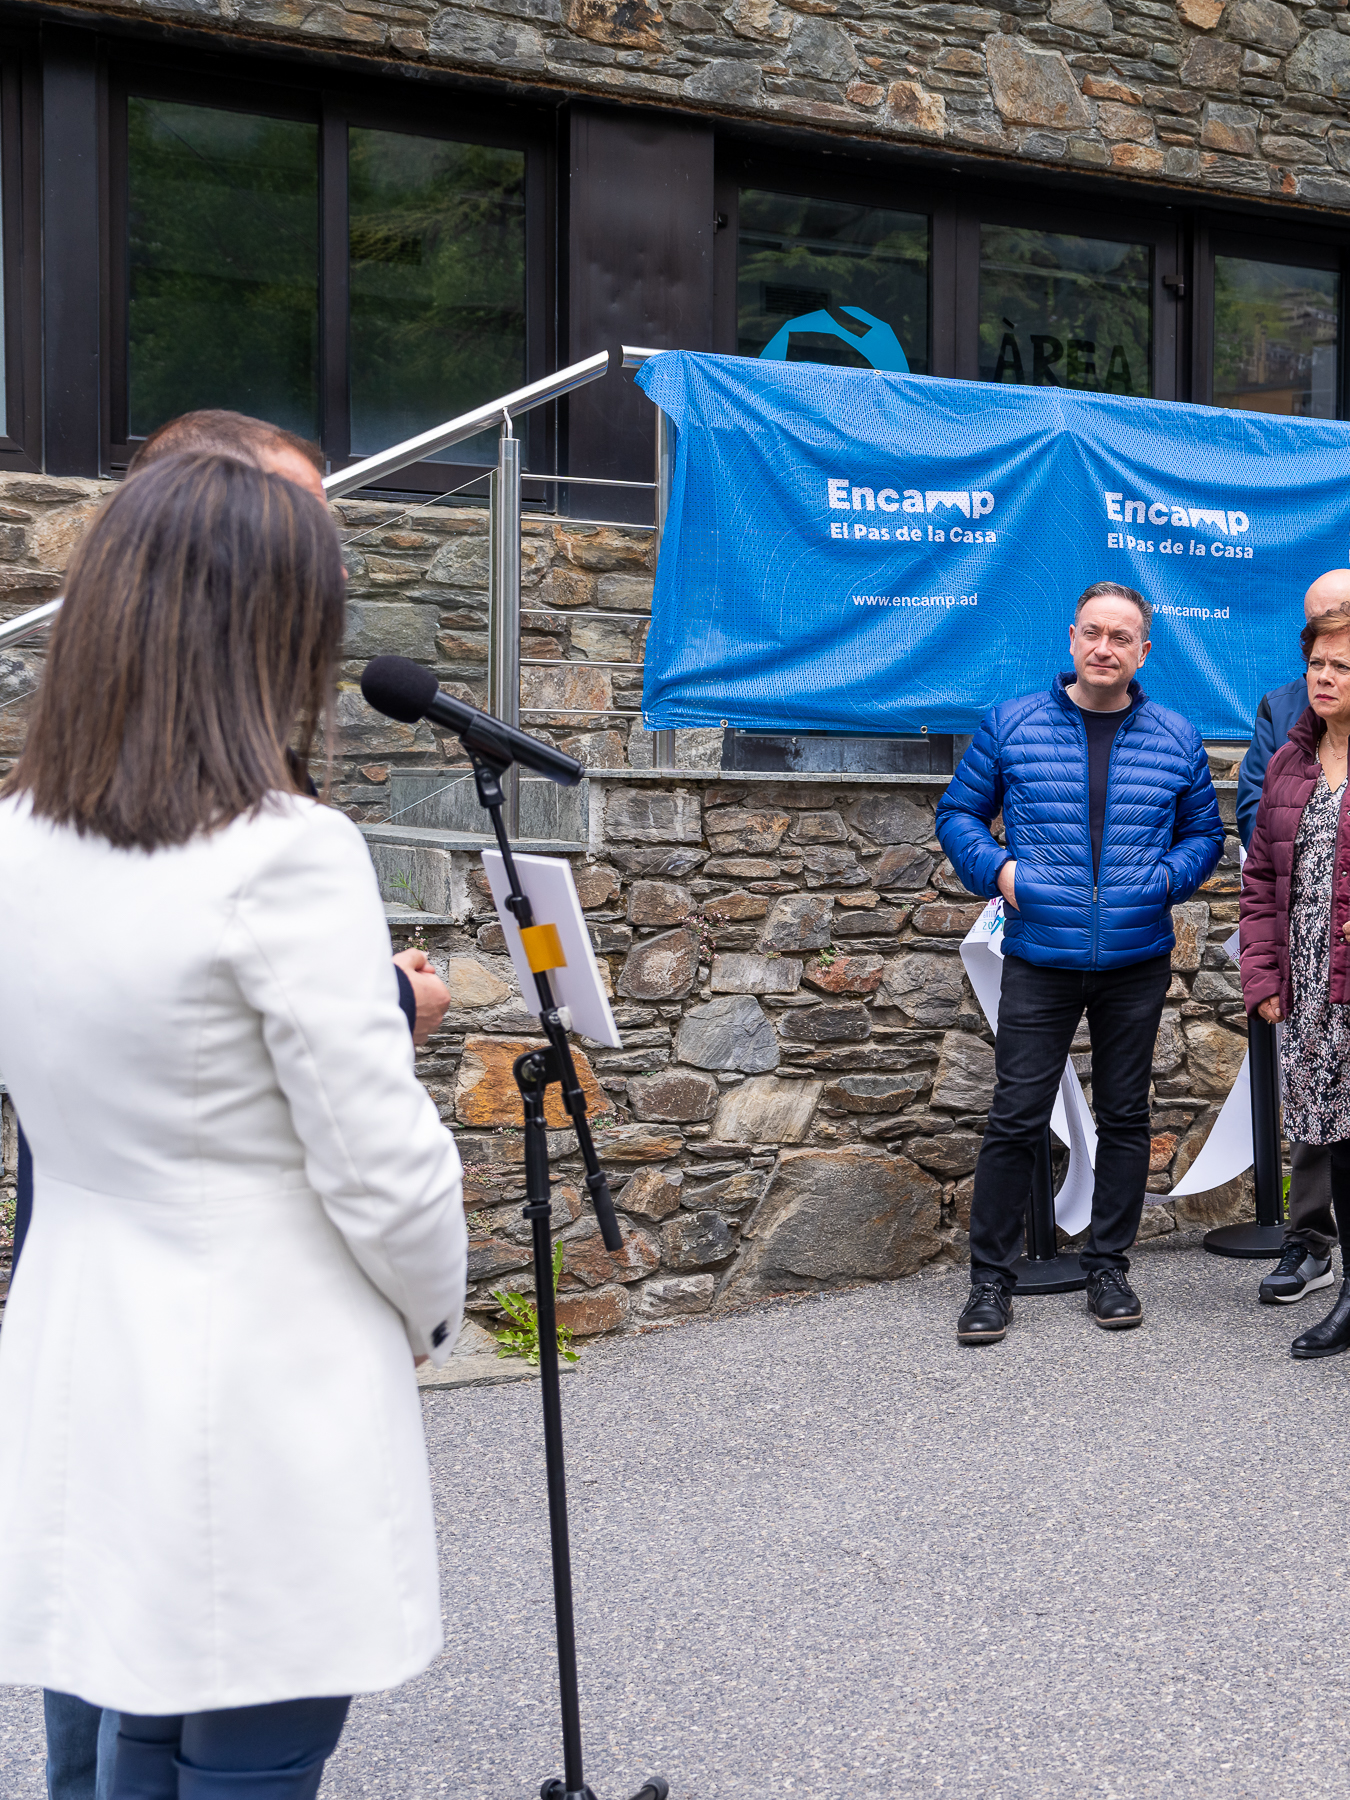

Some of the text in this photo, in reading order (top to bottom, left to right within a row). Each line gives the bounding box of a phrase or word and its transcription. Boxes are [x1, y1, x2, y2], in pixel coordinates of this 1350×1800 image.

[993, 317, 1134, 393] ÀREA
[827, 478, 995, 519] Encamp
[1105, 491, 1250, 536] Encamp
[830, 522, 997, 544] El Pas de la Casa
[1107, 533, 1254, 559] El Pas de la Casa
[852, 593, 978, 608] www.encamp.ad
[1152, 604, 1230, 620] w.encamp.ad
